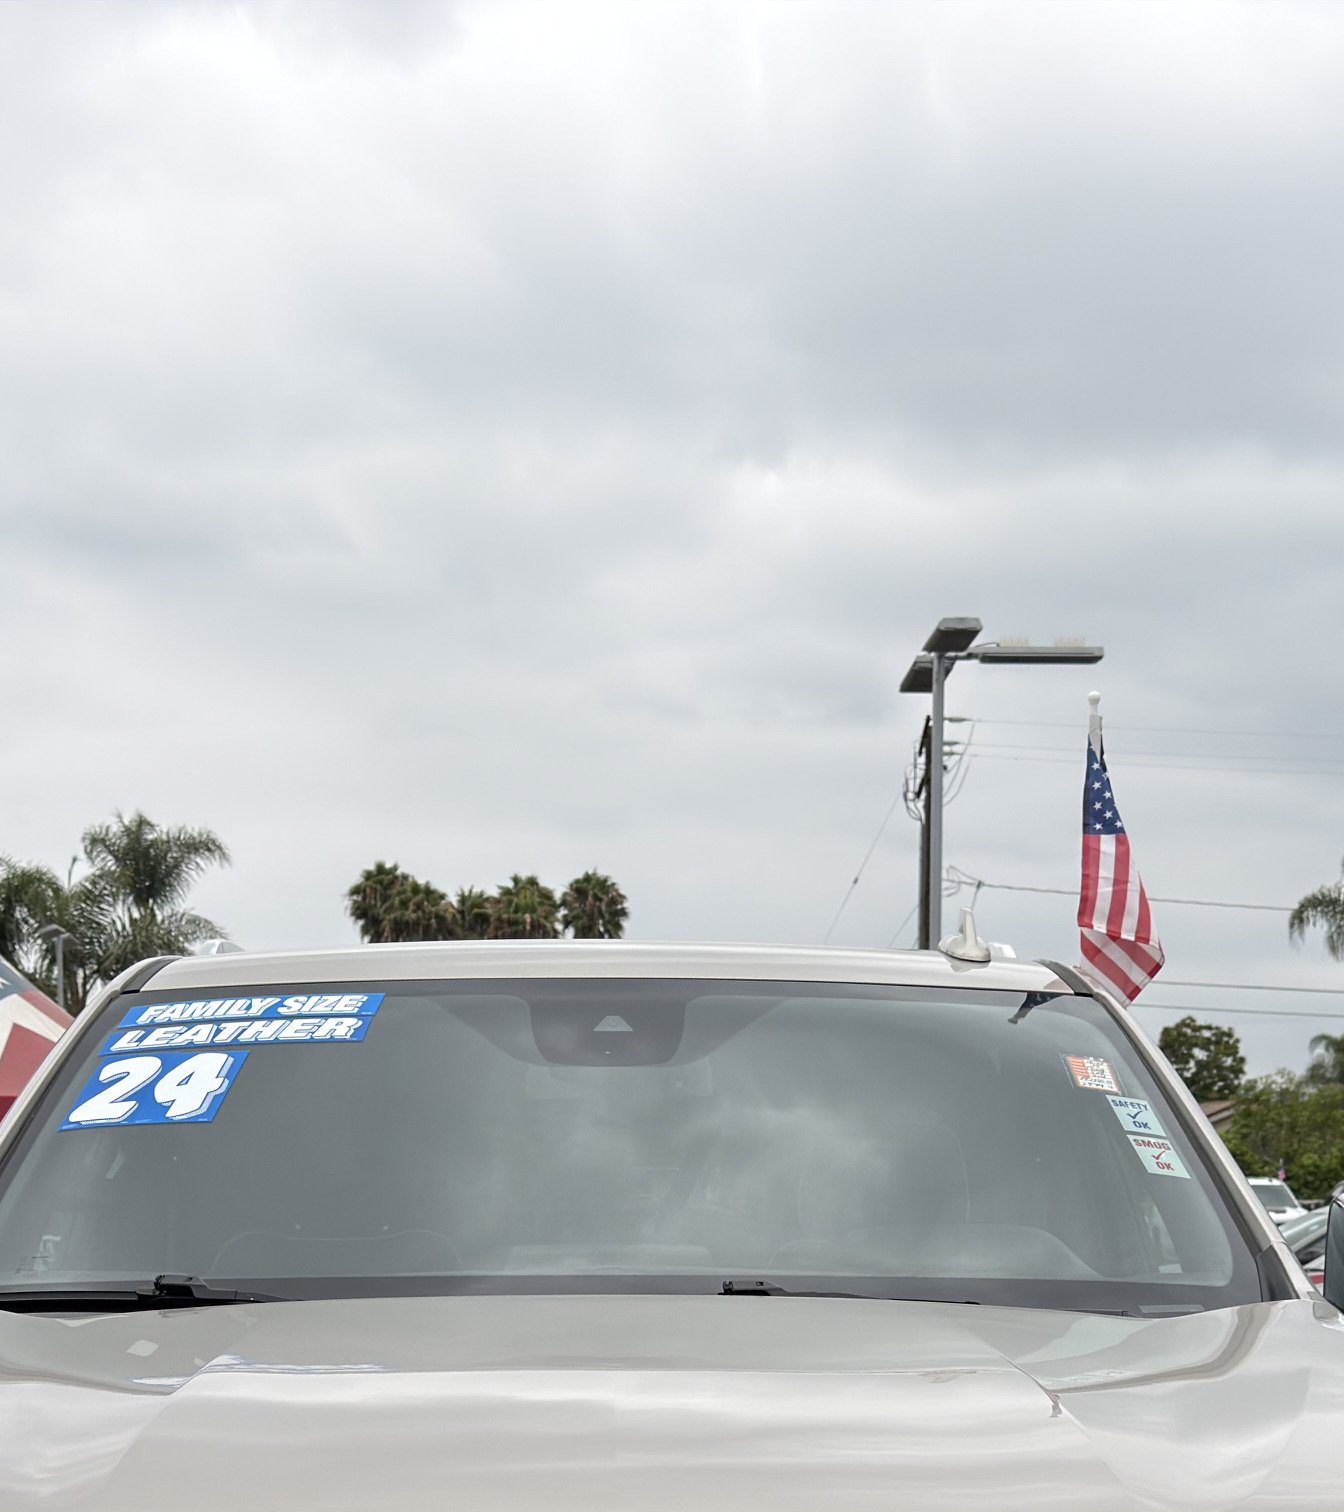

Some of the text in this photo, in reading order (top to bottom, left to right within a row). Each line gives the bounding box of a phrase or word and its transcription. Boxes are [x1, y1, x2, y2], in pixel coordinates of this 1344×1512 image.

[136, 994, 369, 1025] FAMILY SIZE
[110, 1017, 364, 1052] LEATHER
[68, 1052, 231, 1125] 24
[1111, 1099, 1148, 1111] SAFETY
[1133, 1120, 1151, 1130] OK
[1133, 1139, 1171, 1151] SMOG
[1156, 1161, 1175, 1171] OK
